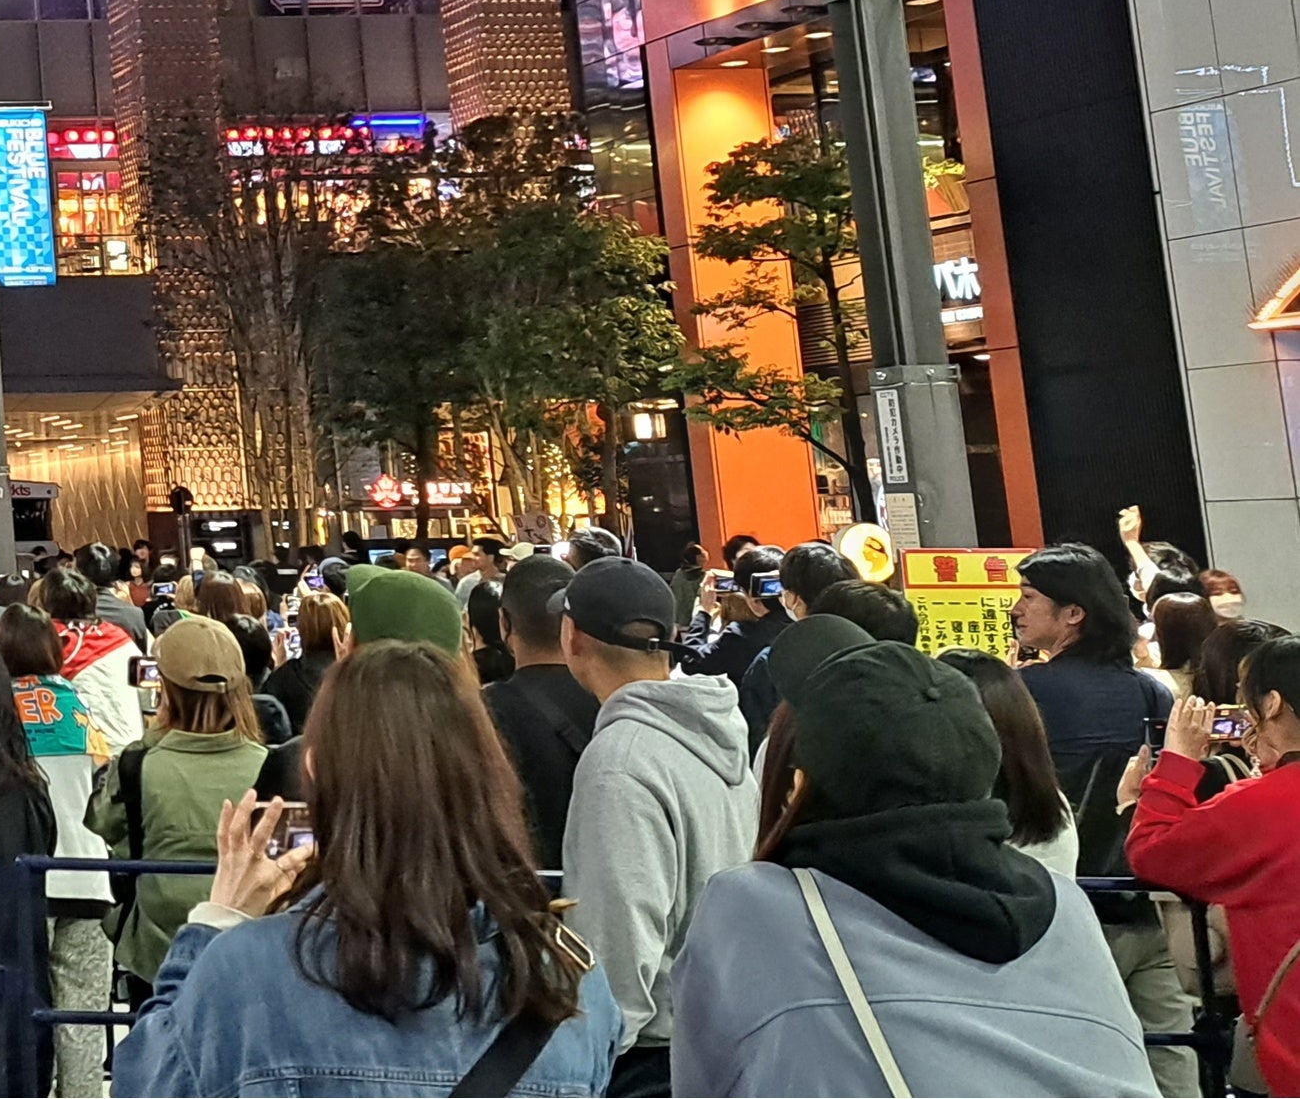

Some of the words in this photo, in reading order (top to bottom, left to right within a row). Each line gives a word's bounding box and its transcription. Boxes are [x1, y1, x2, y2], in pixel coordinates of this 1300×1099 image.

[5, 128, 35, 227] FESTIVAL
[24, 127, 47, 180] BLUE
[932, 555, 1009, 583] 警告
[980, 596, 1000, 656] に違反する
[13, 687, 64, 725] ER
